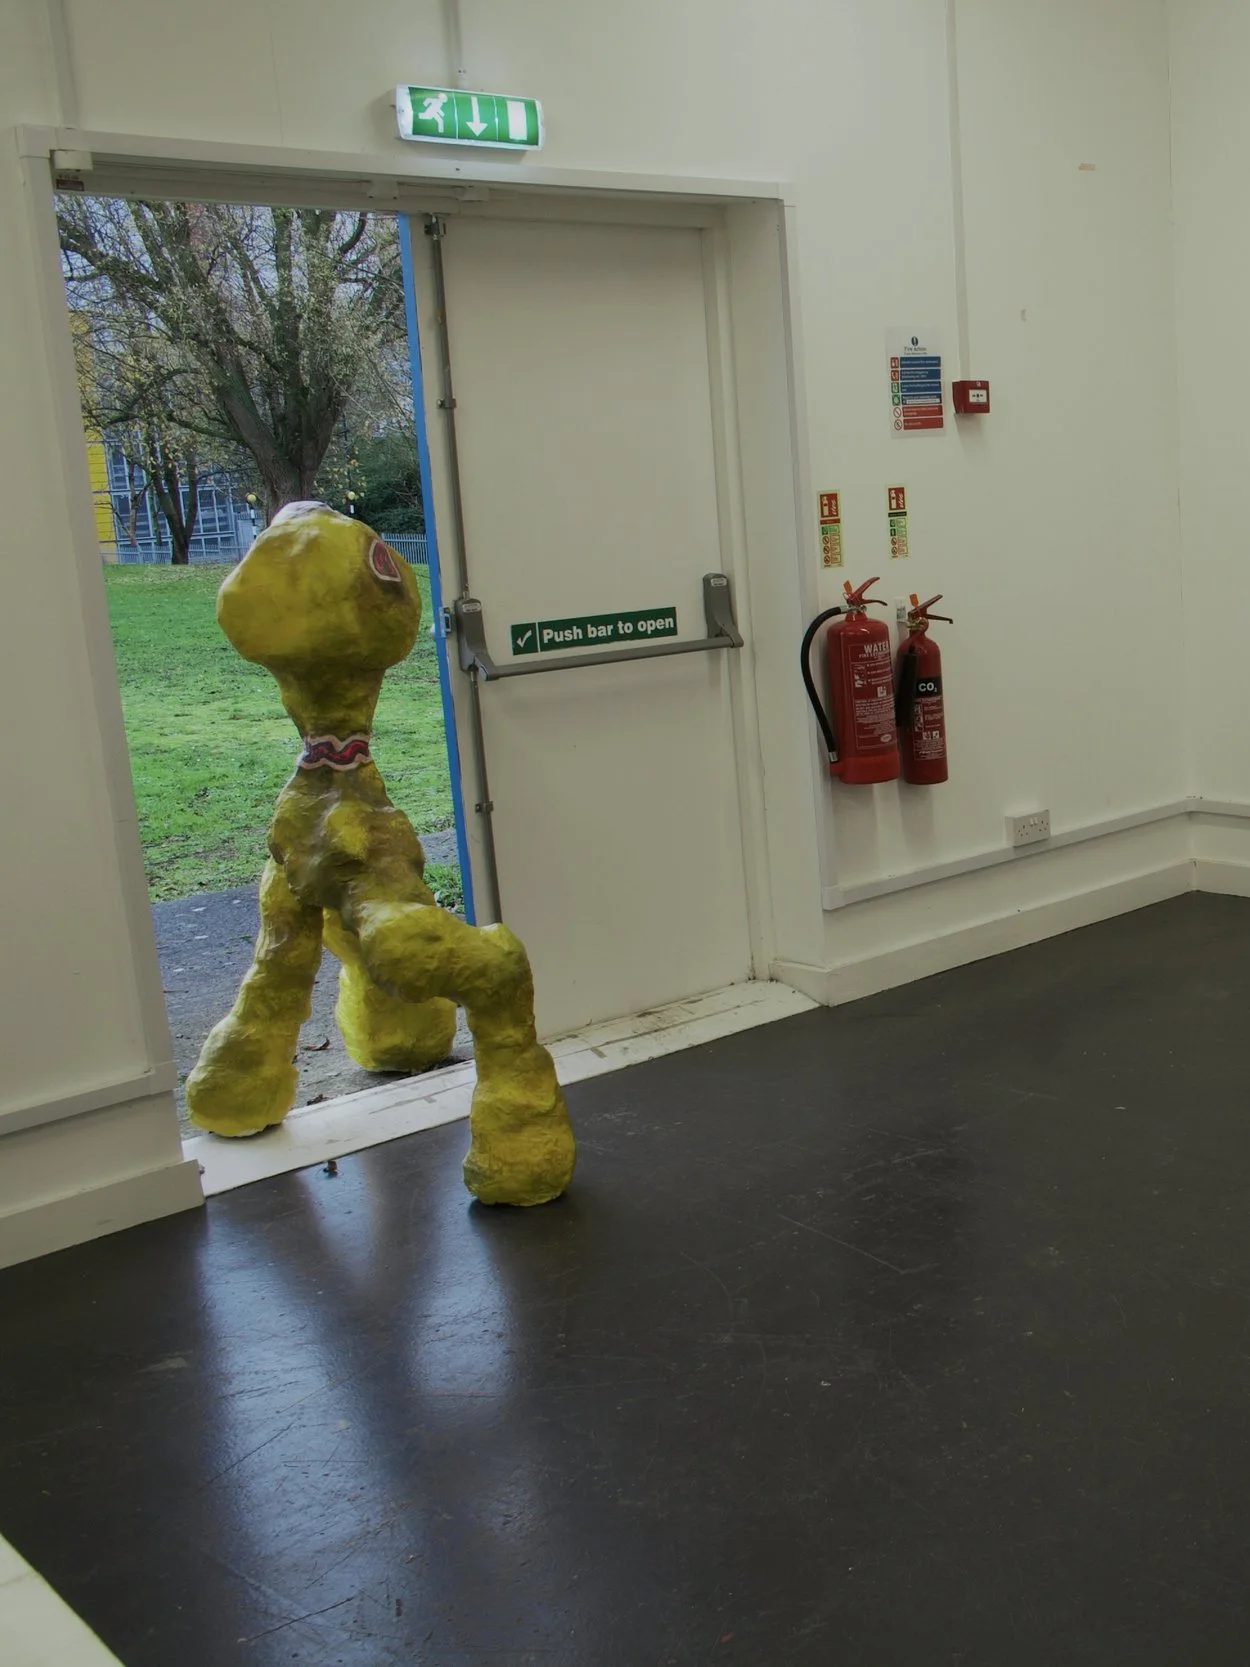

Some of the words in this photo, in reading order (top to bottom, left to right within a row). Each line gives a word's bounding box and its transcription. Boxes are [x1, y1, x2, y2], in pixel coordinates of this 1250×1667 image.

[543, 623, 583, 644] Push
[587, 624, 614, 639] bar
[617, 621, 633, 635] to
[638, 616, 674, 634] open
